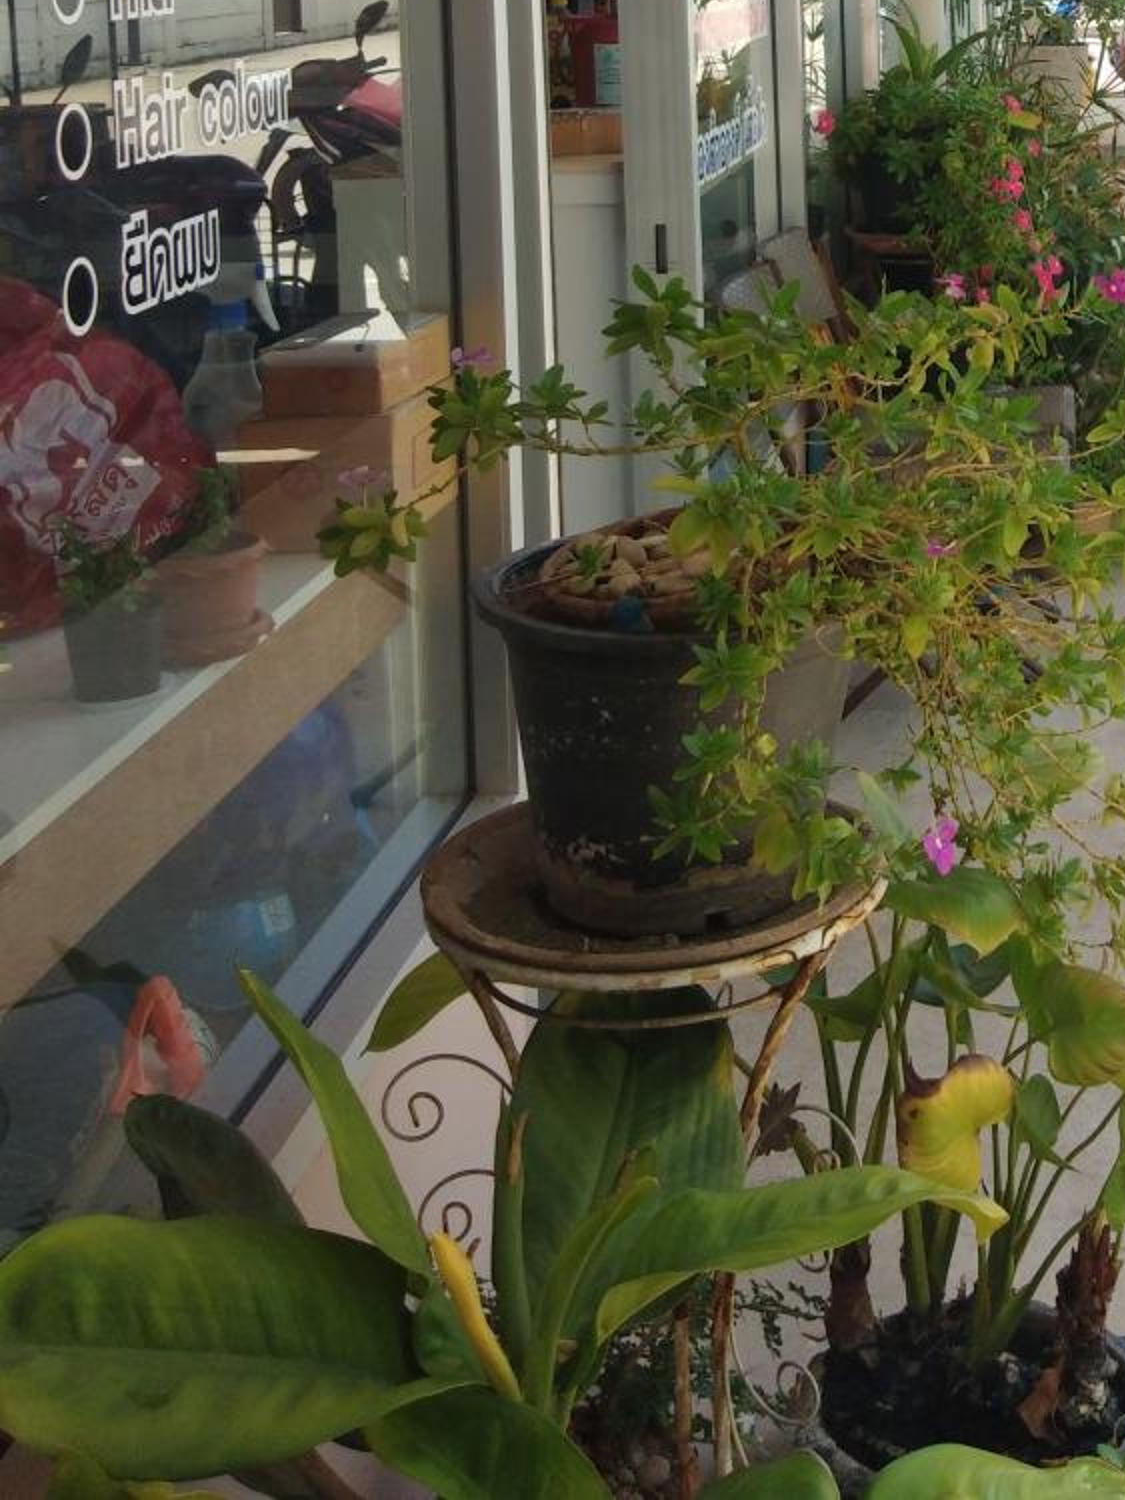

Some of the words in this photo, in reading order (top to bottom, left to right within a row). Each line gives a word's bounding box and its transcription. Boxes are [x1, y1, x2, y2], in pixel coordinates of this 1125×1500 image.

[113, 72, 187, 169] Hair
[199, 59, 293, 146] colour
[121, 209, 221, 315] ยืดผม
